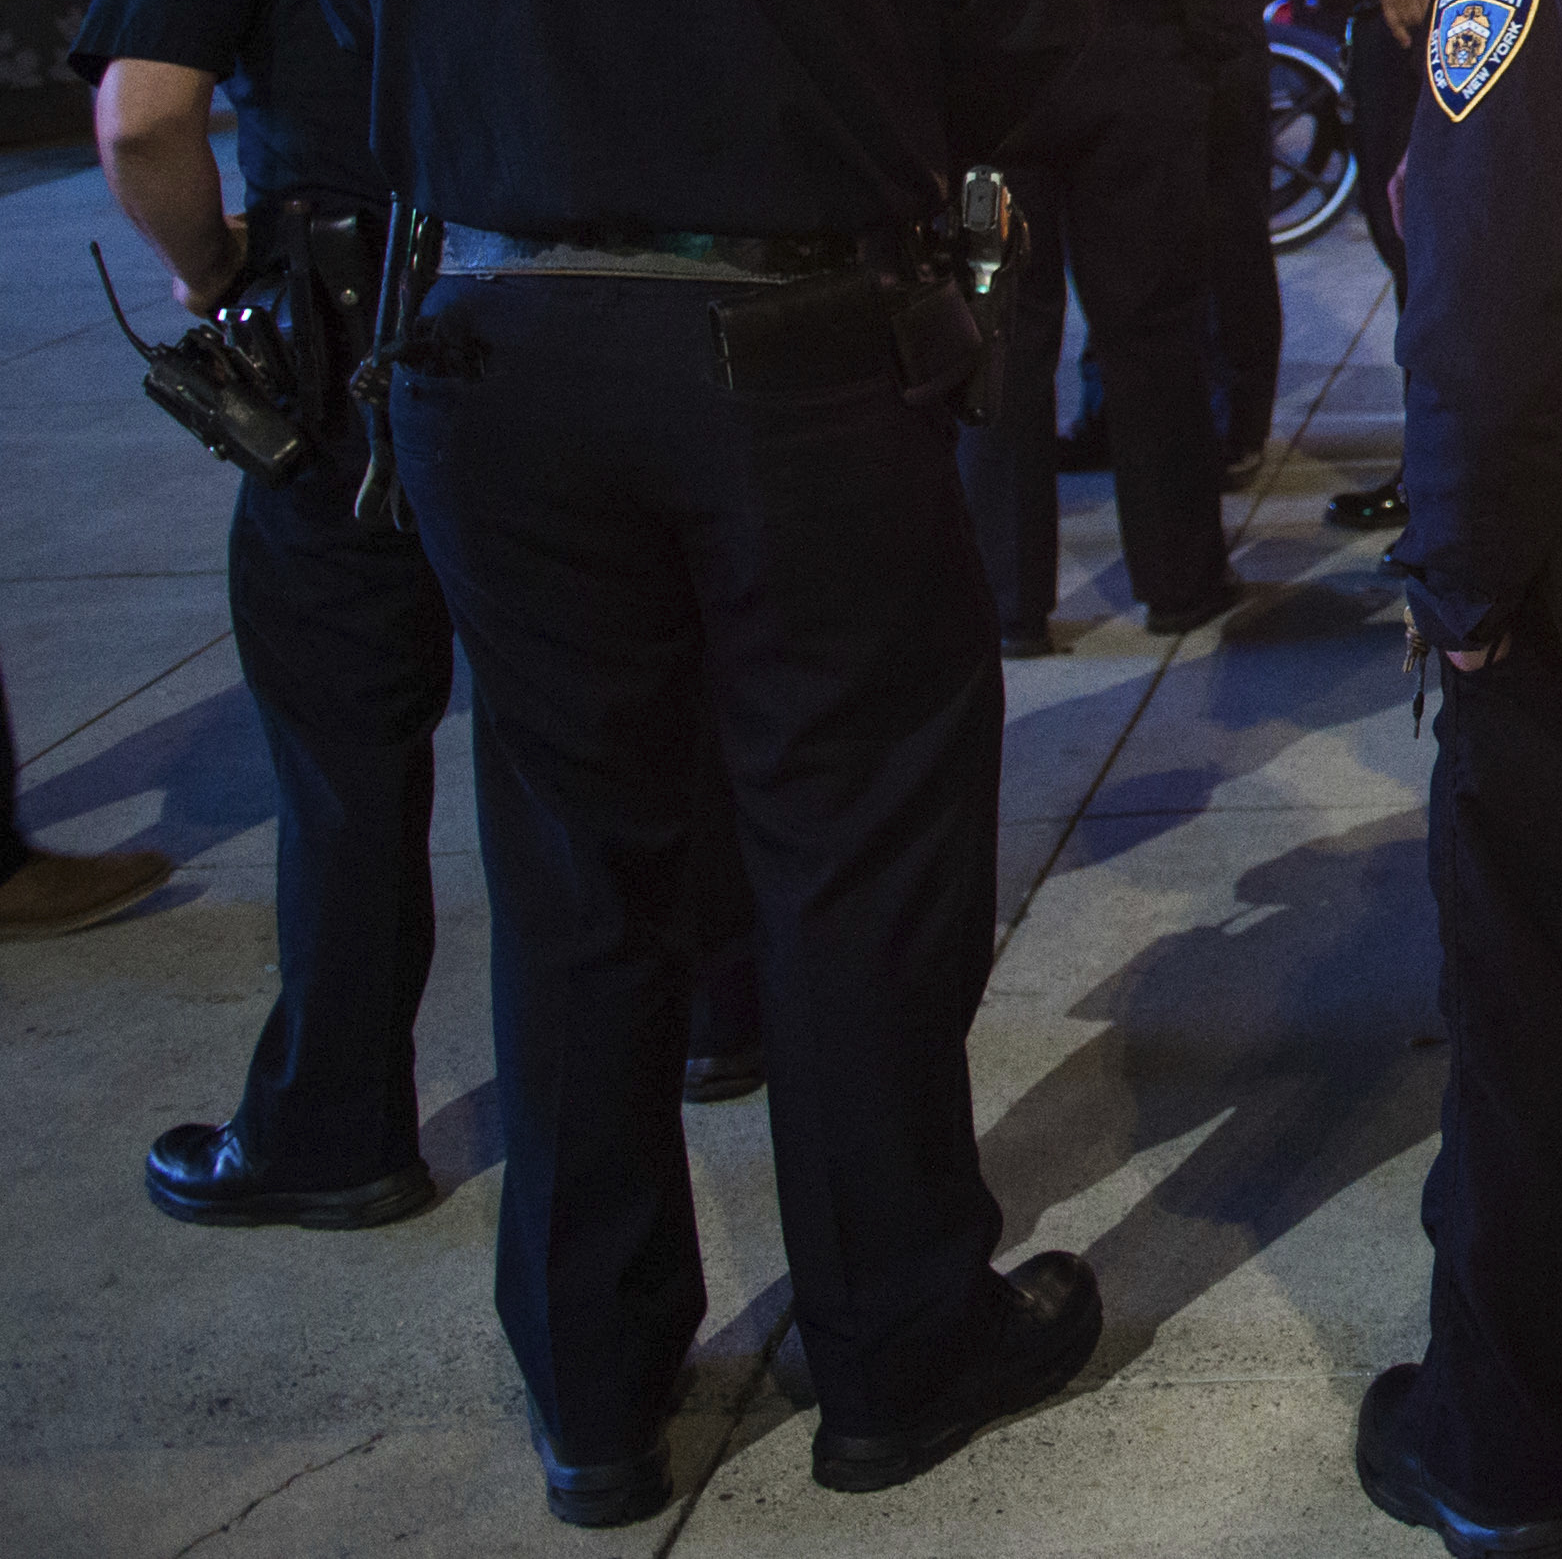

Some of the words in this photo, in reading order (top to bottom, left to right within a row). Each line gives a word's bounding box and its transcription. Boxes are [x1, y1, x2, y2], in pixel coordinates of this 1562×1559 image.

[1434, 69, 1448, 89] OF
[1462, 67, 1490, 100] NEW
[1488, 21, 1523, 65] YORK
